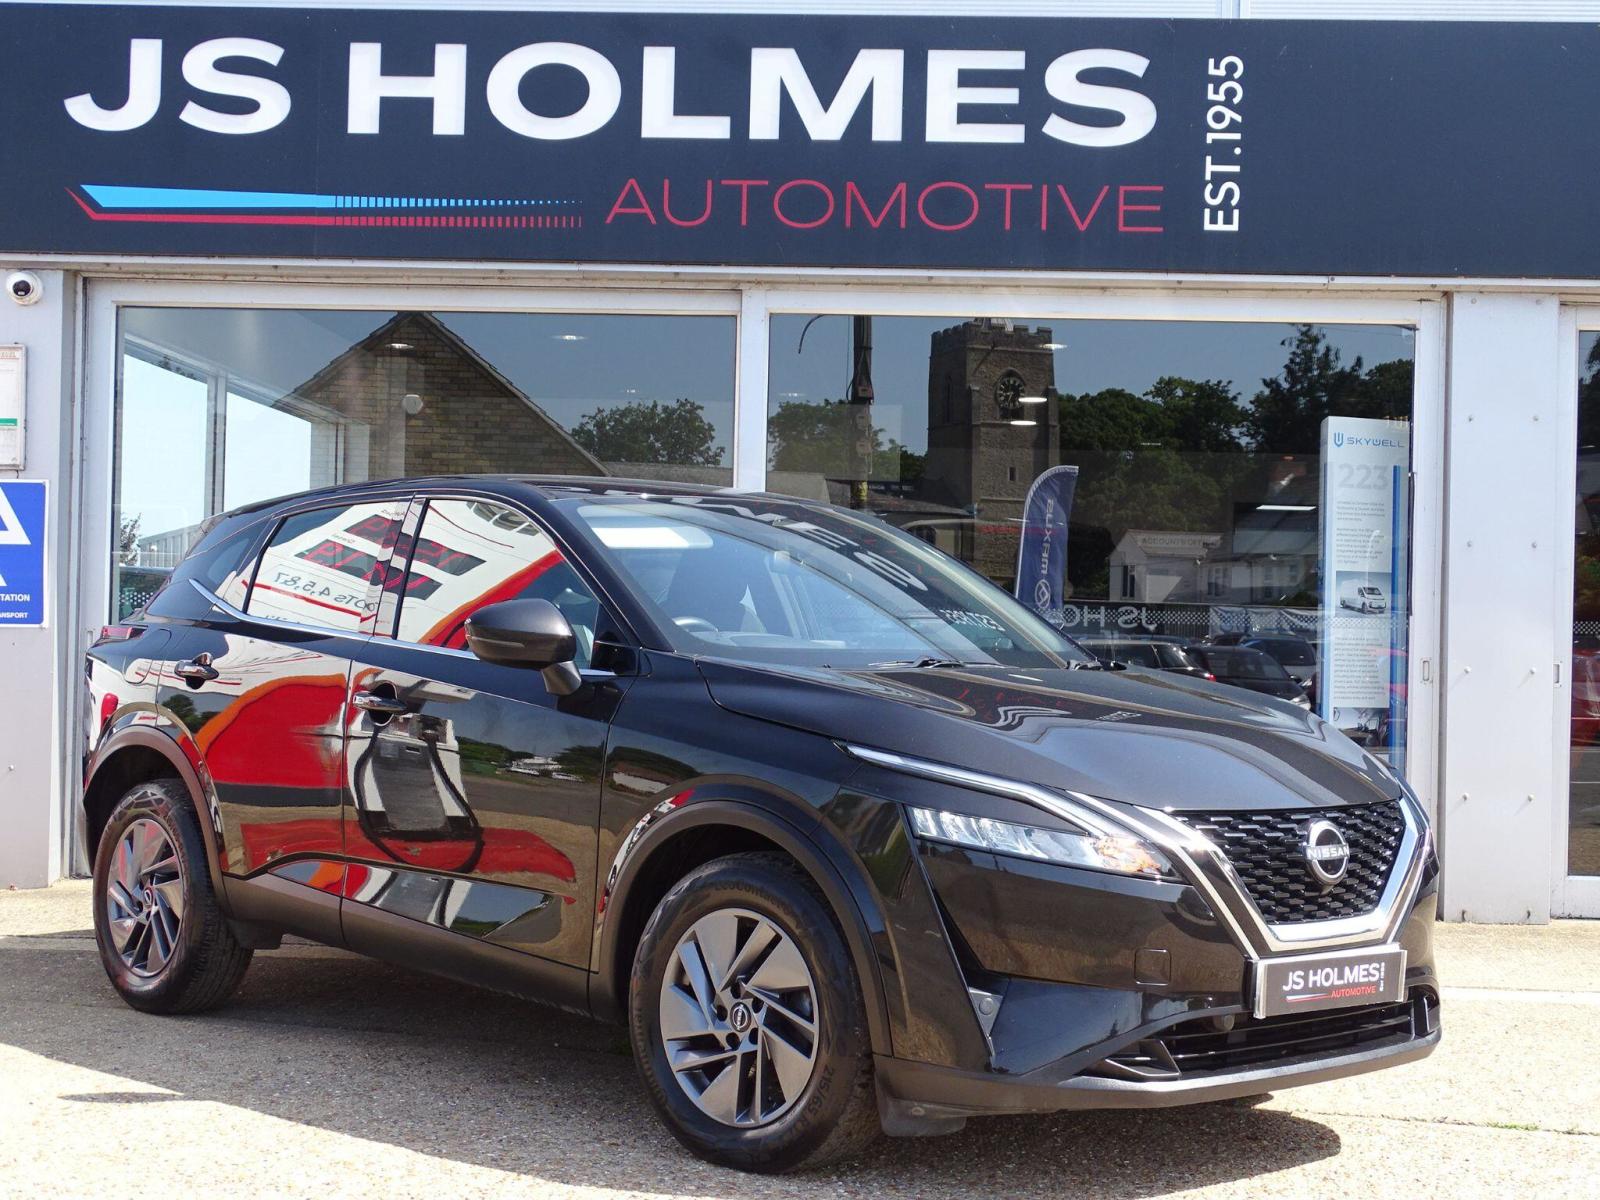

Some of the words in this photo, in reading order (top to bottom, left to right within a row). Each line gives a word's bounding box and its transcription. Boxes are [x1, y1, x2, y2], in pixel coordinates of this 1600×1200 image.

[64, 37, 291, 135] JS
[347, 42, 1157, 148] HOLMES
[1204, 55, 1245, 232] EST.1955
[605, 178, 1165, 233] AUTOMOTIVE
[1346, 436, 1405, 448] SKYWELL
[1338, 462, 1389, 489] 223
[0, 593, 30, 602] TATION
[1306, 845, 1350, 860] NISSAN
[1282, 970, 1305, 992] JS
[1308, 962, 1380, 989] HOLMES
[1330, 984, 1377, 999] AUTOMOTIVE
